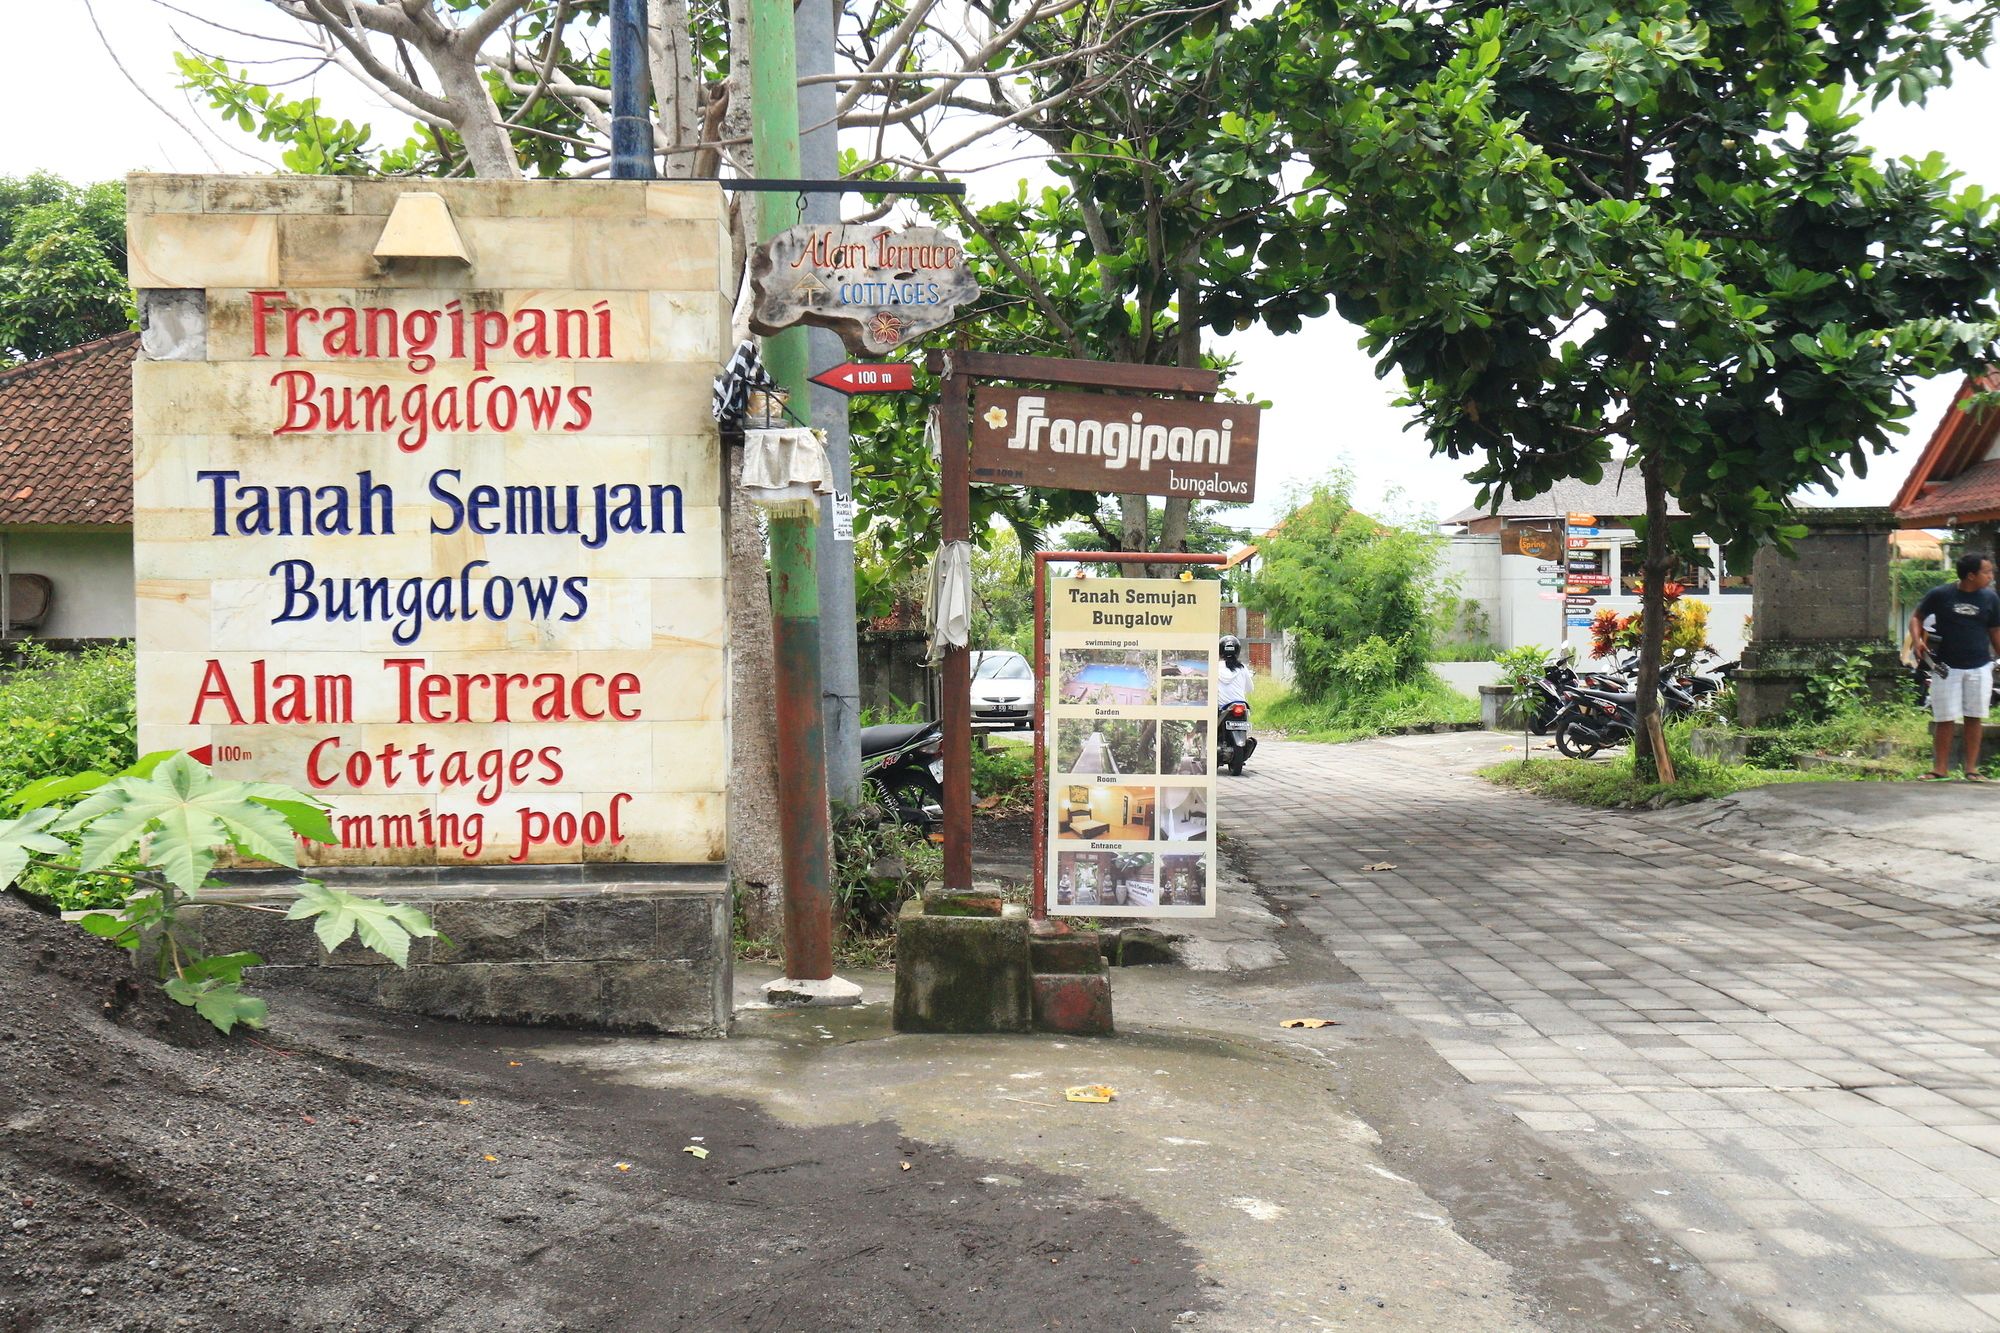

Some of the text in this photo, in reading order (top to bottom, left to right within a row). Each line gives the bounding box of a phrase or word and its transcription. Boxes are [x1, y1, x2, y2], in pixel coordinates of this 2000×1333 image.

[791, 229, 957, 270] Alam Terrace
[840, 282, 941, 305] COTTAGES
[247, 290, 613, 374] Frangipani
[858, 370, 892, 384] 100 m
[271, 369, 593, 453] Bungalows
[1008, 395, 1234, 471] Frangipani
[1170, 469, 1248, 496] bungalows
[197, 468, 685, 549] Tanah Semujan
[1522, 541, 1546, 549] Spring
[1569, 539, 1584, 547] LOVE
[269, 559, 589, 646] Bungalows
[1069, 588, 1197, 608] Tanah Semujan
[1092, 610, 1173, 629] Bungalow
[1085, 639, 1139, 647] swimming pool
[189, 658, 641, 725] Alam Terrace
[1095, 708, 1120, 716] Garden
[217, 746, 253, 761] 100 m
[306, 736, 564, 807] Cottages
[294, 793, 633, 863] mming pool
[1090, 842, 1122, 850] Entrance
